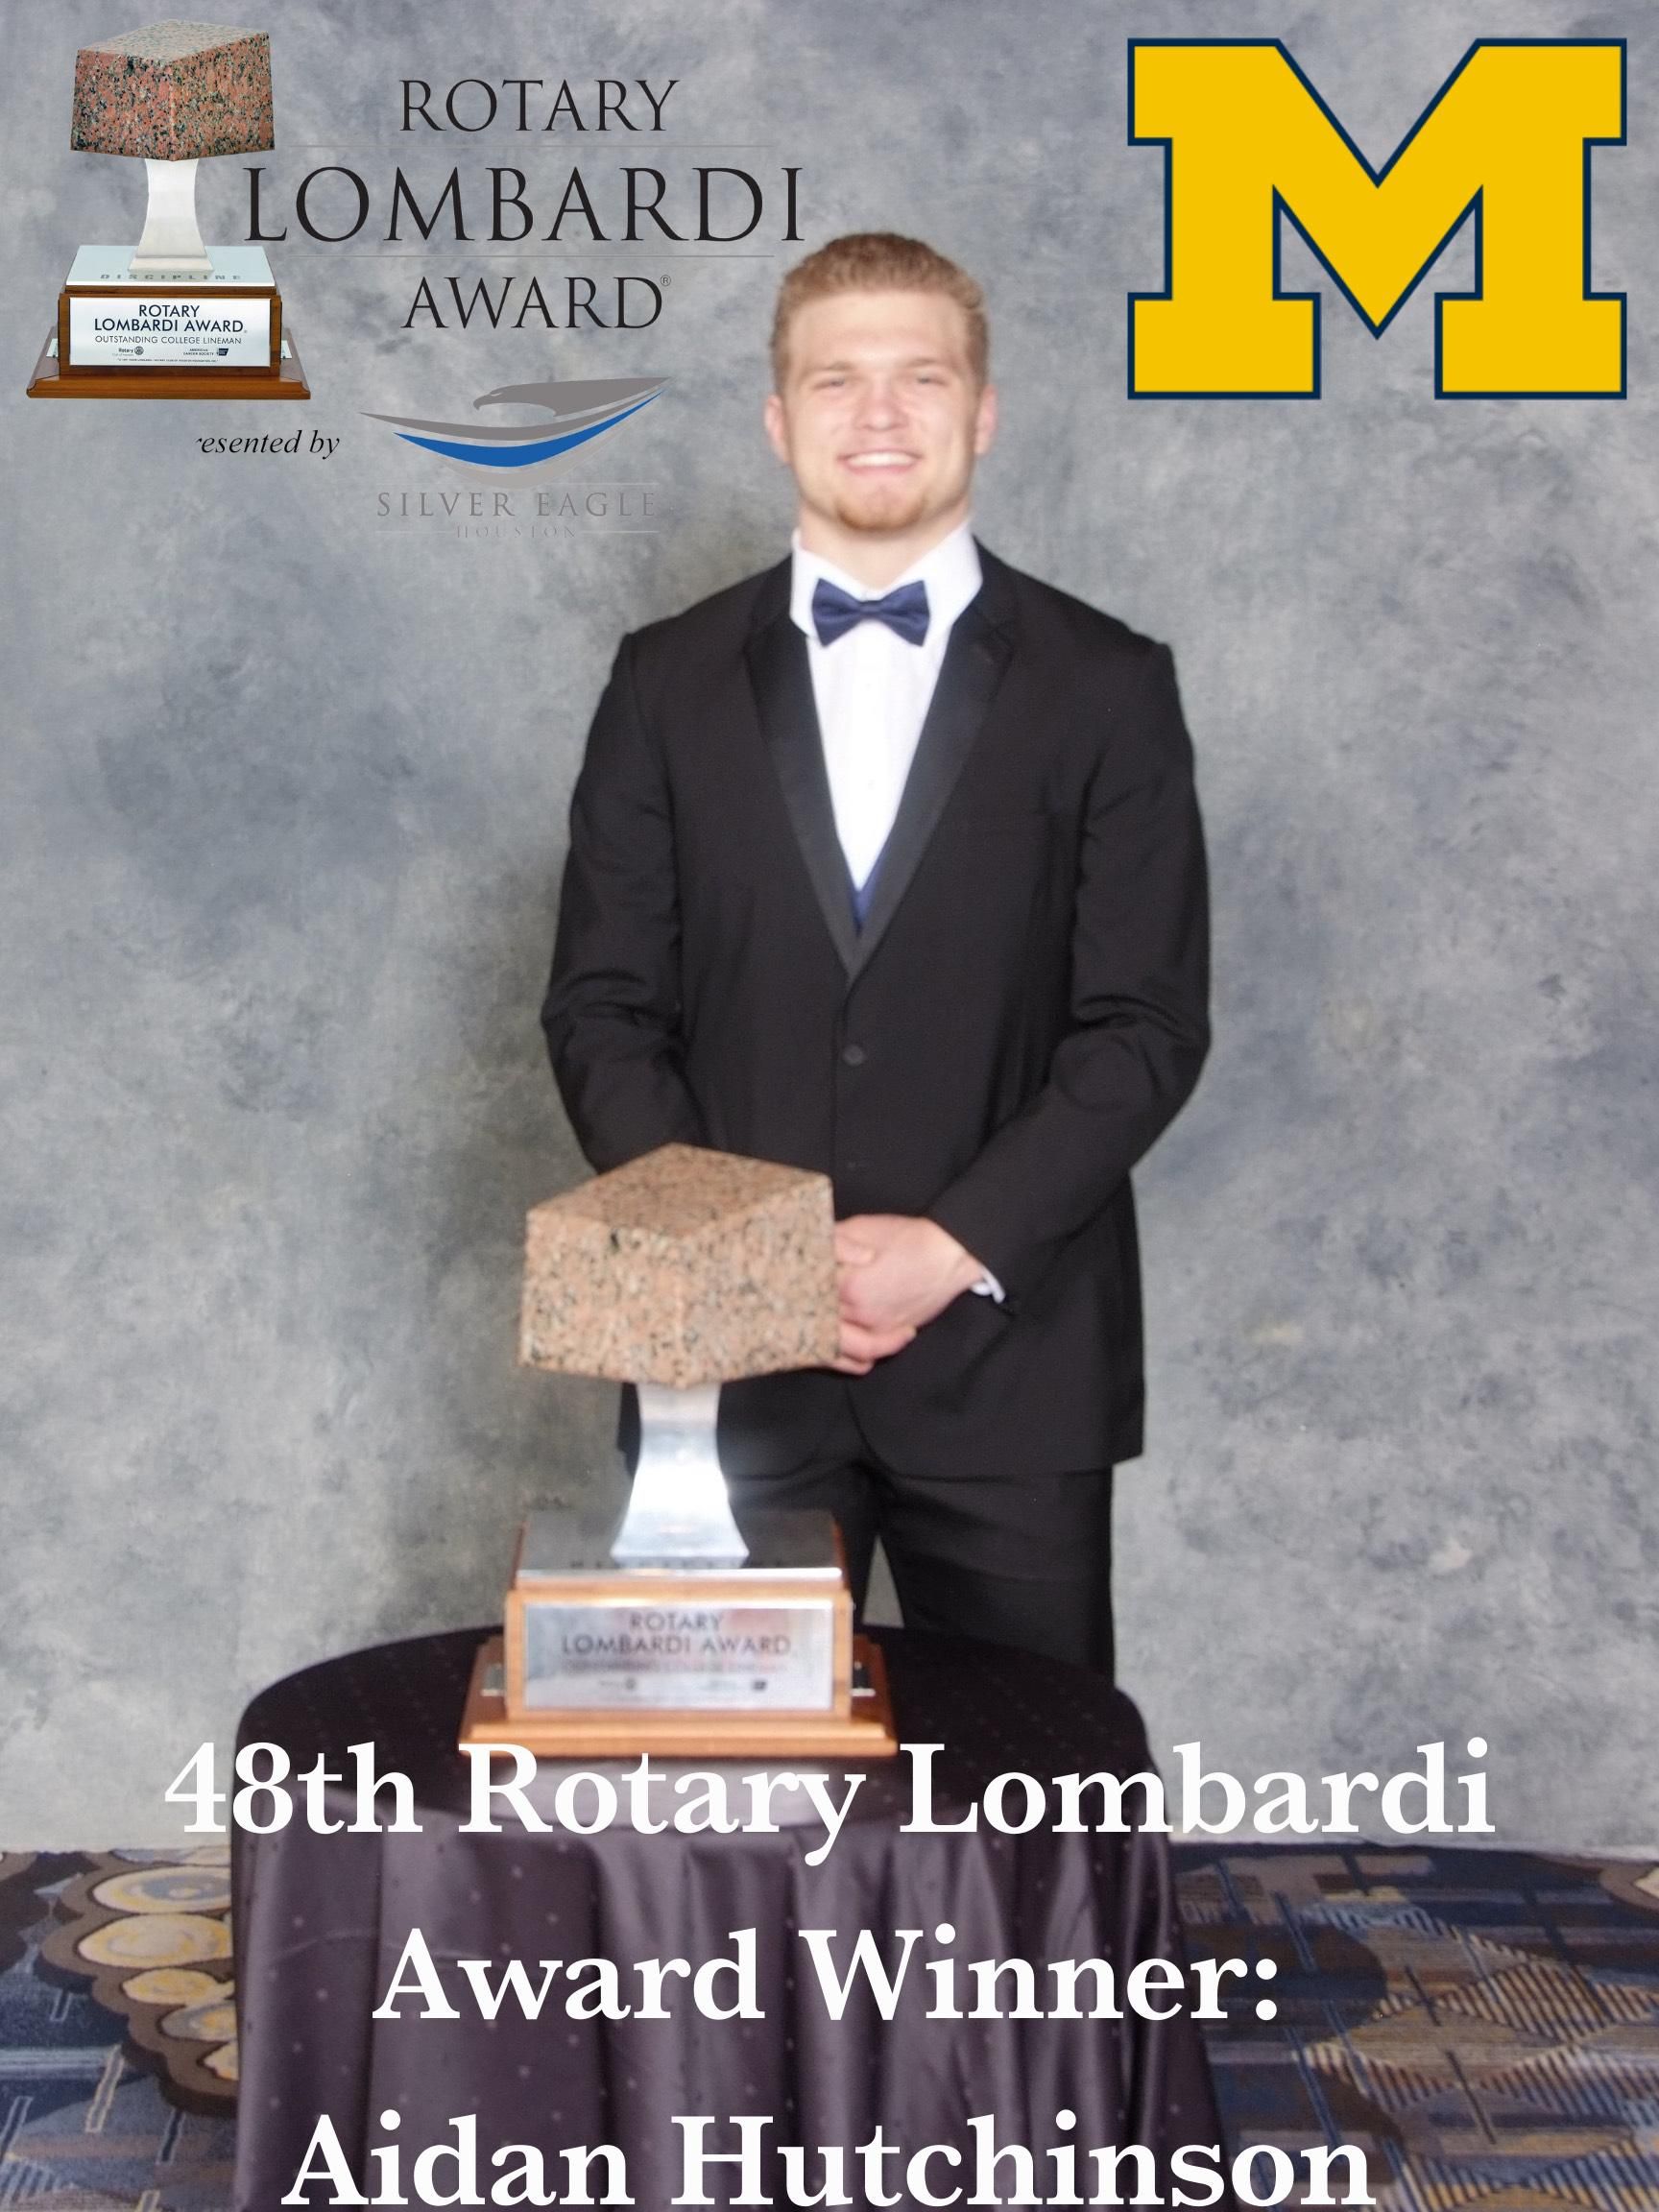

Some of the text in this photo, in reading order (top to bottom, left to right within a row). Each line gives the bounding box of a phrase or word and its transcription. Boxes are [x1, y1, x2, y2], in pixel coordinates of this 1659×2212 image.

[629, 1611, 724, 1632] ROTARY
[562, 1634, 792, 1655] LOMBARDI AWARD
